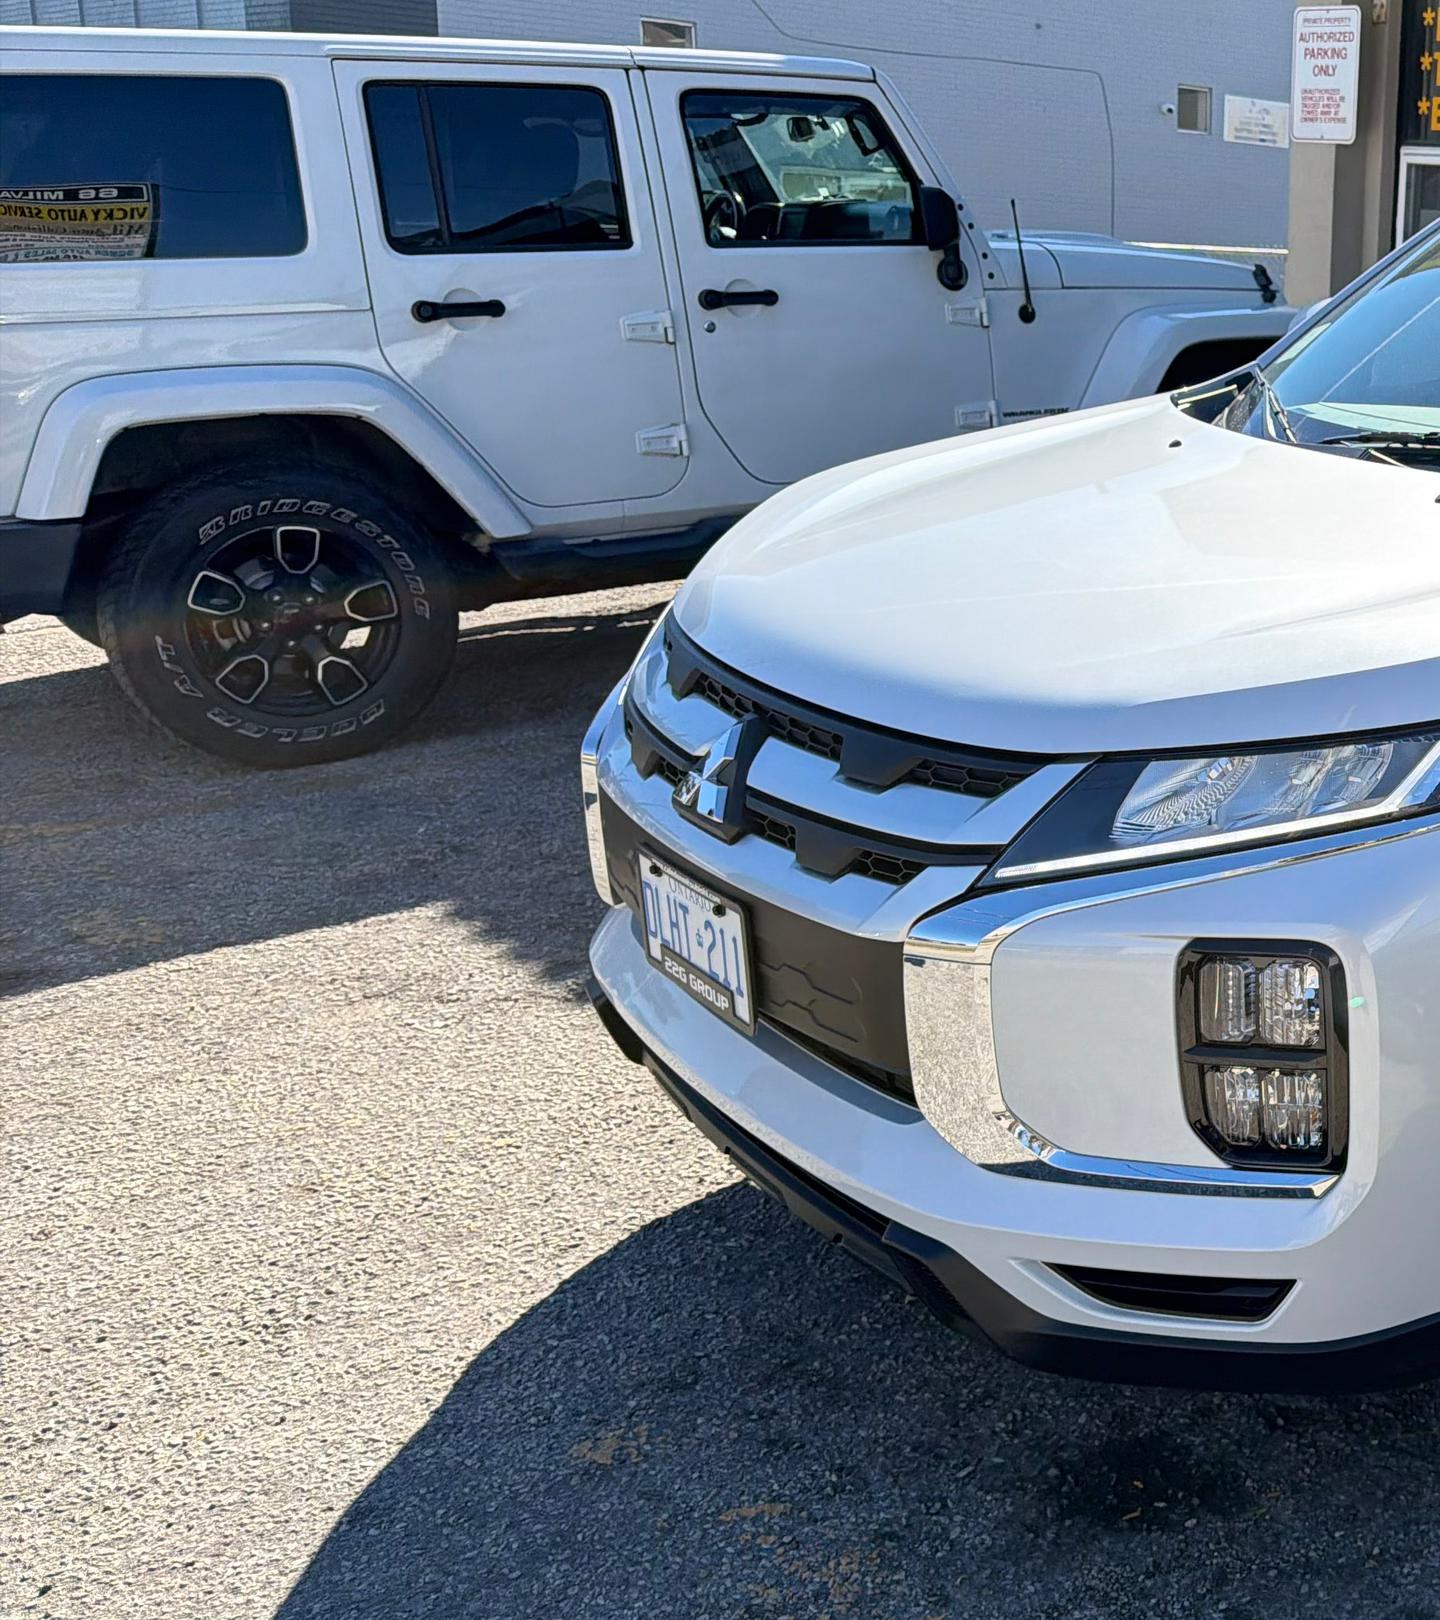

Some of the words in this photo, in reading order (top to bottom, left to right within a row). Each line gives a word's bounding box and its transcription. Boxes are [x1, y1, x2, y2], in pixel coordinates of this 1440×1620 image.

[1298, 31, 1355, 43] AUTHORIZED
[1303, 47, 1348, 60] PARKING
[1312, 64, 1338, 77] ONLY
[198, 498, 431, 621] BRIDGESTONE
[667, 876, 713, 913] ONTARIO
[643, 880, 692, 962] DLHT
[704, 919, 745, 998] 211
[688, 973, 730, 1011] GROUP
